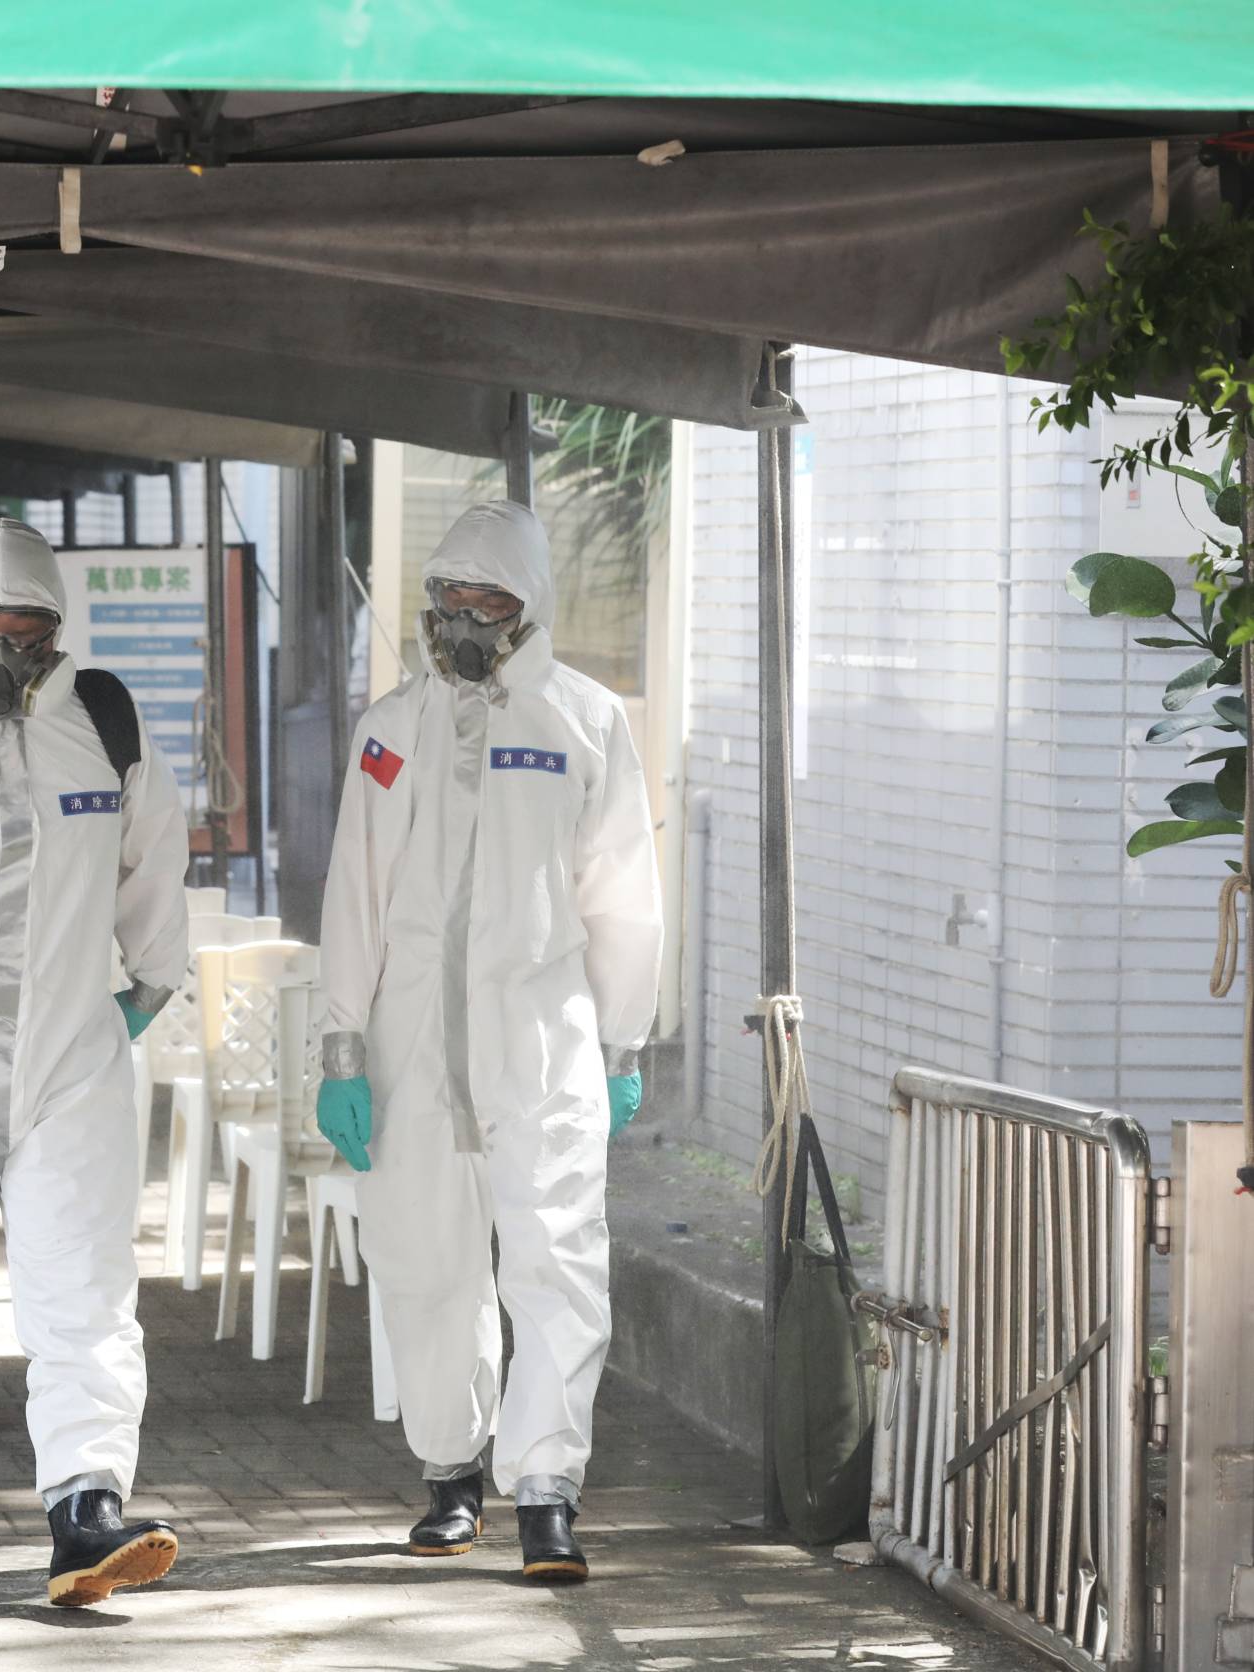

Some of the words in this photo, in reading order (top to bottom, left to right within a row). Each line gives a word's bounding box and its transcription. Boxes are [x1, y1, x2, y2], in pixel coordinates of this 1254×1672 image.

[86, 566, 190, 592] 萬華專案
[500, 752, 557, 769] 消除兵
